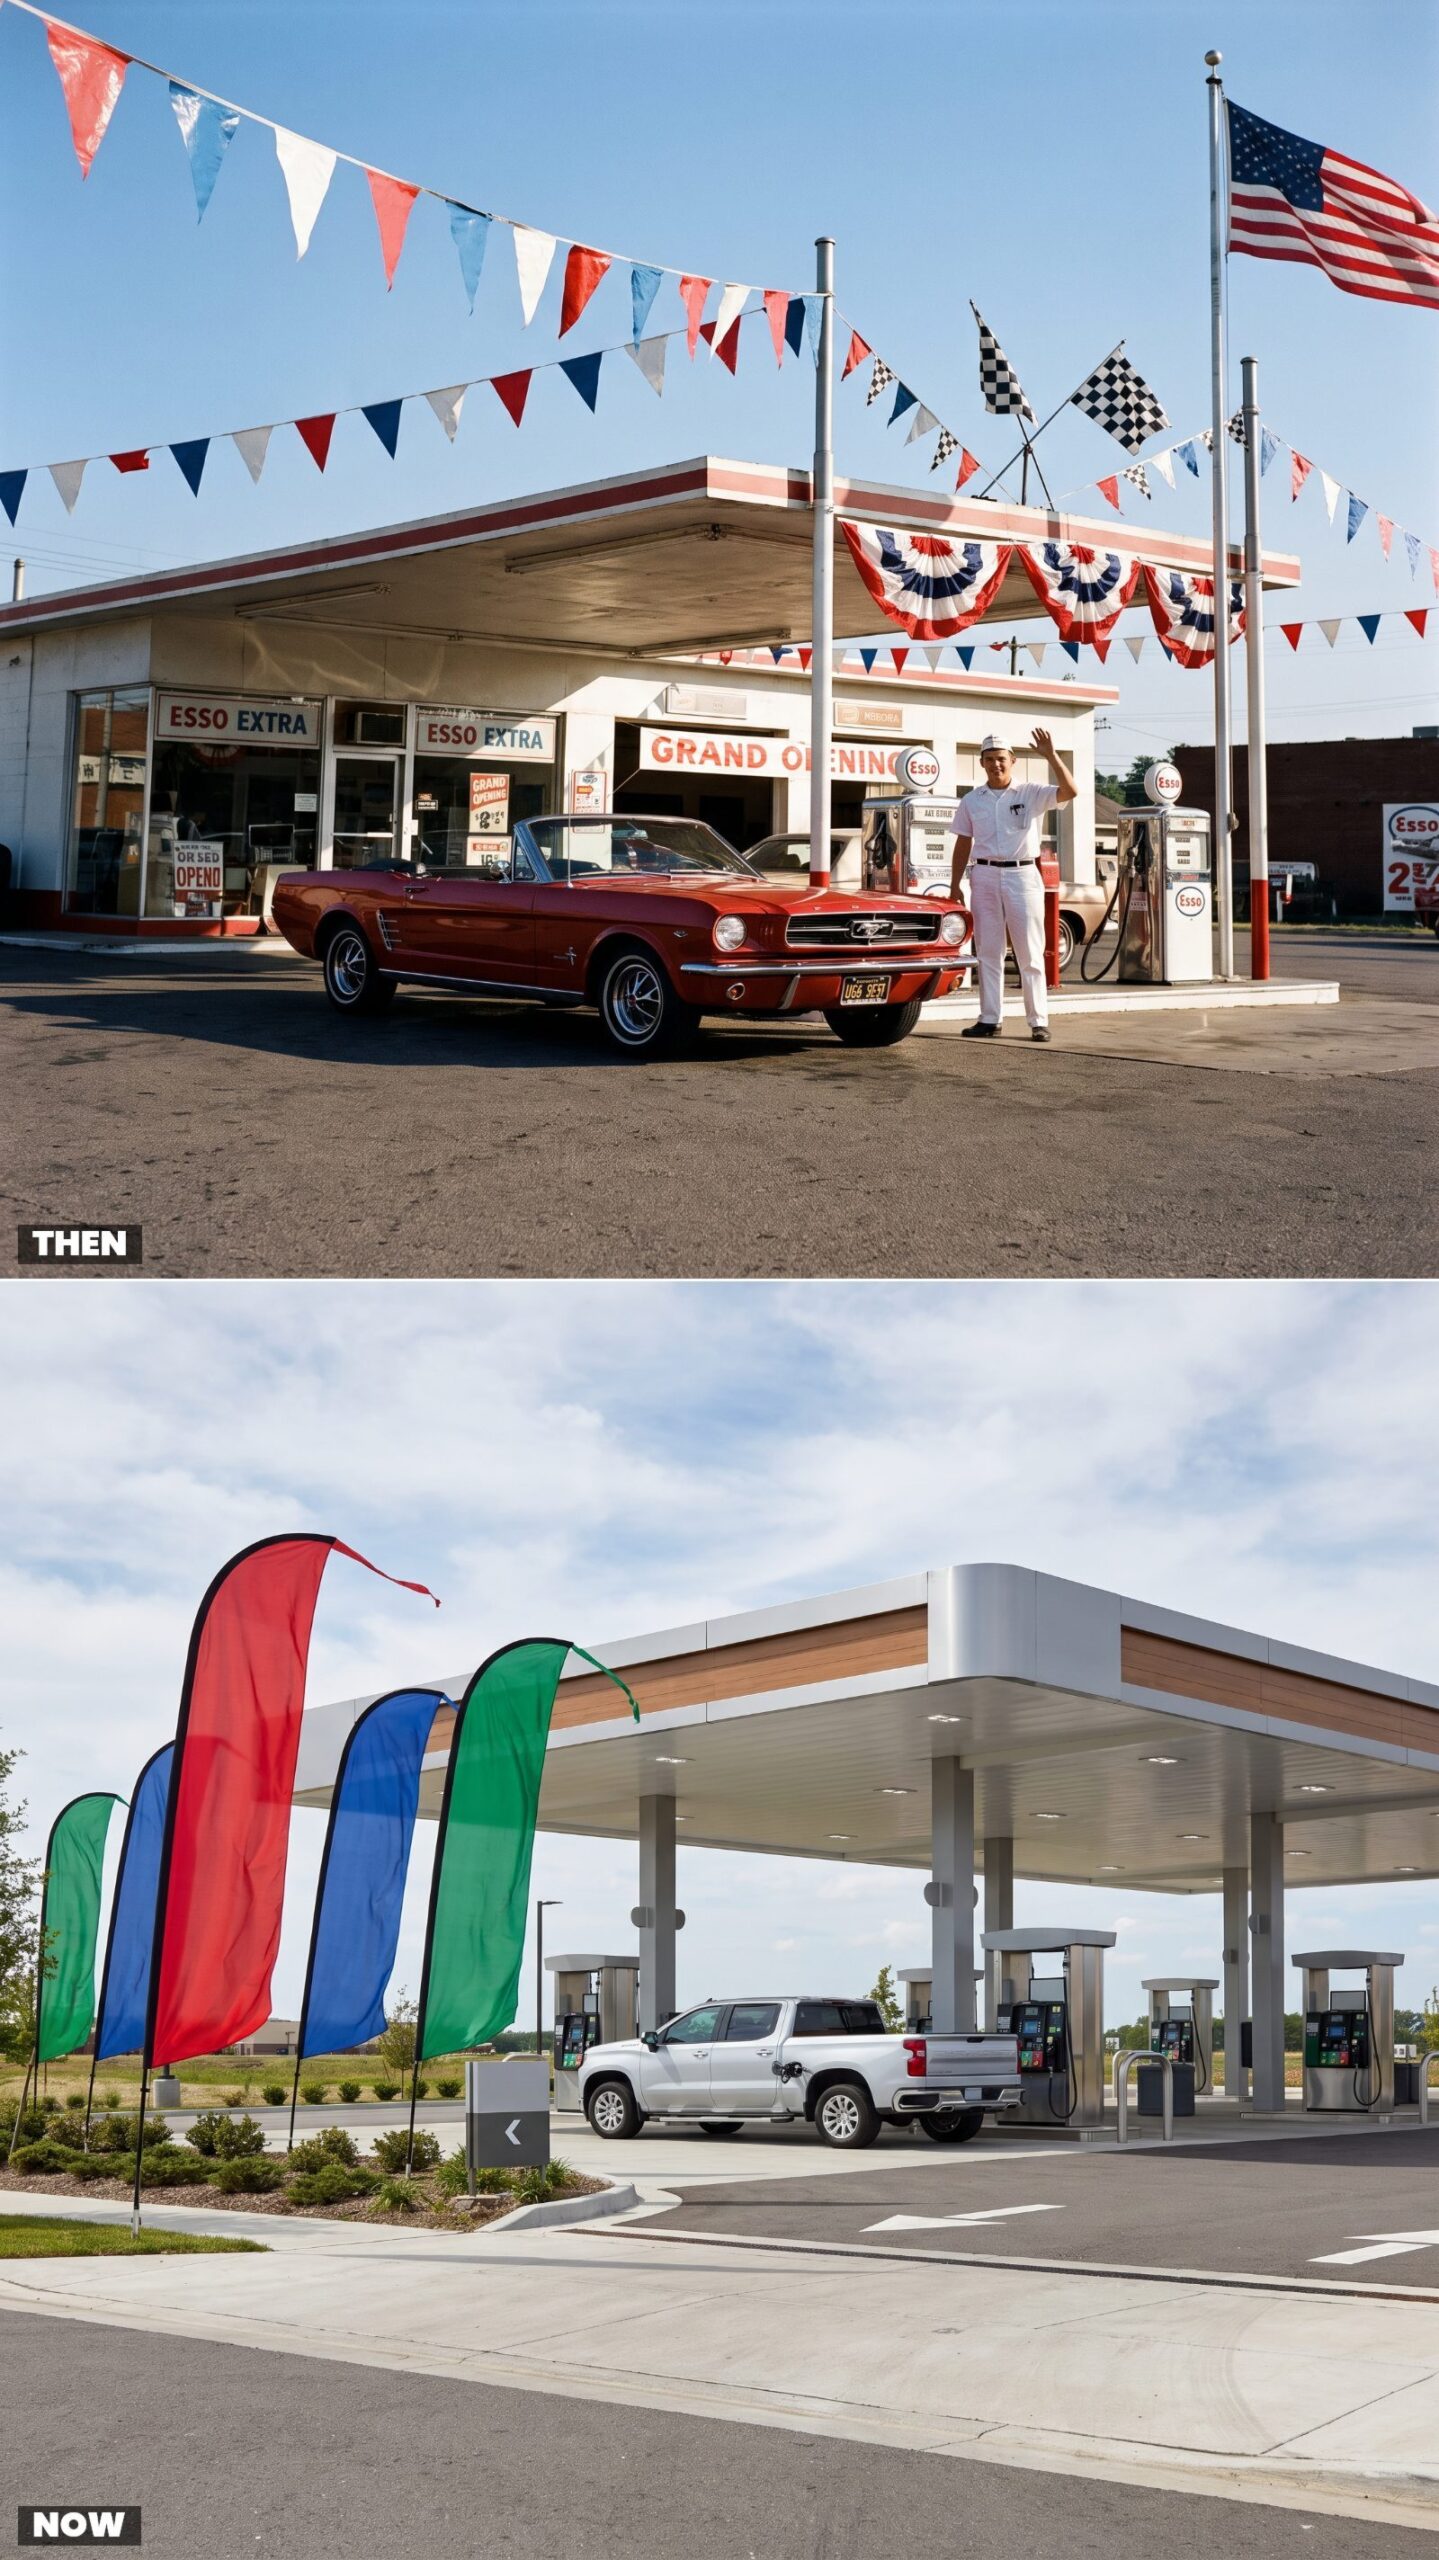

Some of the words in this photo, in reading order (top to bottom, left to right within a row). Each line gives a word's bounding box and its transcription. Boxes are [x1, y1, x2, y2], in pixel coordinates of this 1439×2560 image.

[170, 705, 229, 730] ESSO
[237, 710, 307, 735] EXTRA
[427, 723, 477, 745] ESSO
[484, 727, 543, 750] EXTRA
[651, 735, 768, 769] GRAND
[910, 761, 937, 775] Esso
[472, 776, 506, 793] GRAND
[1158, 776, 1180, 789] Esso
[472, 788, 507, 805] OPENING
[1395, 816, 1439, 833] Esso
[177, 852, 195, 863] OR
[197, 852, 220, 863] SED
[1179, 894, 1202, 907] Esso
